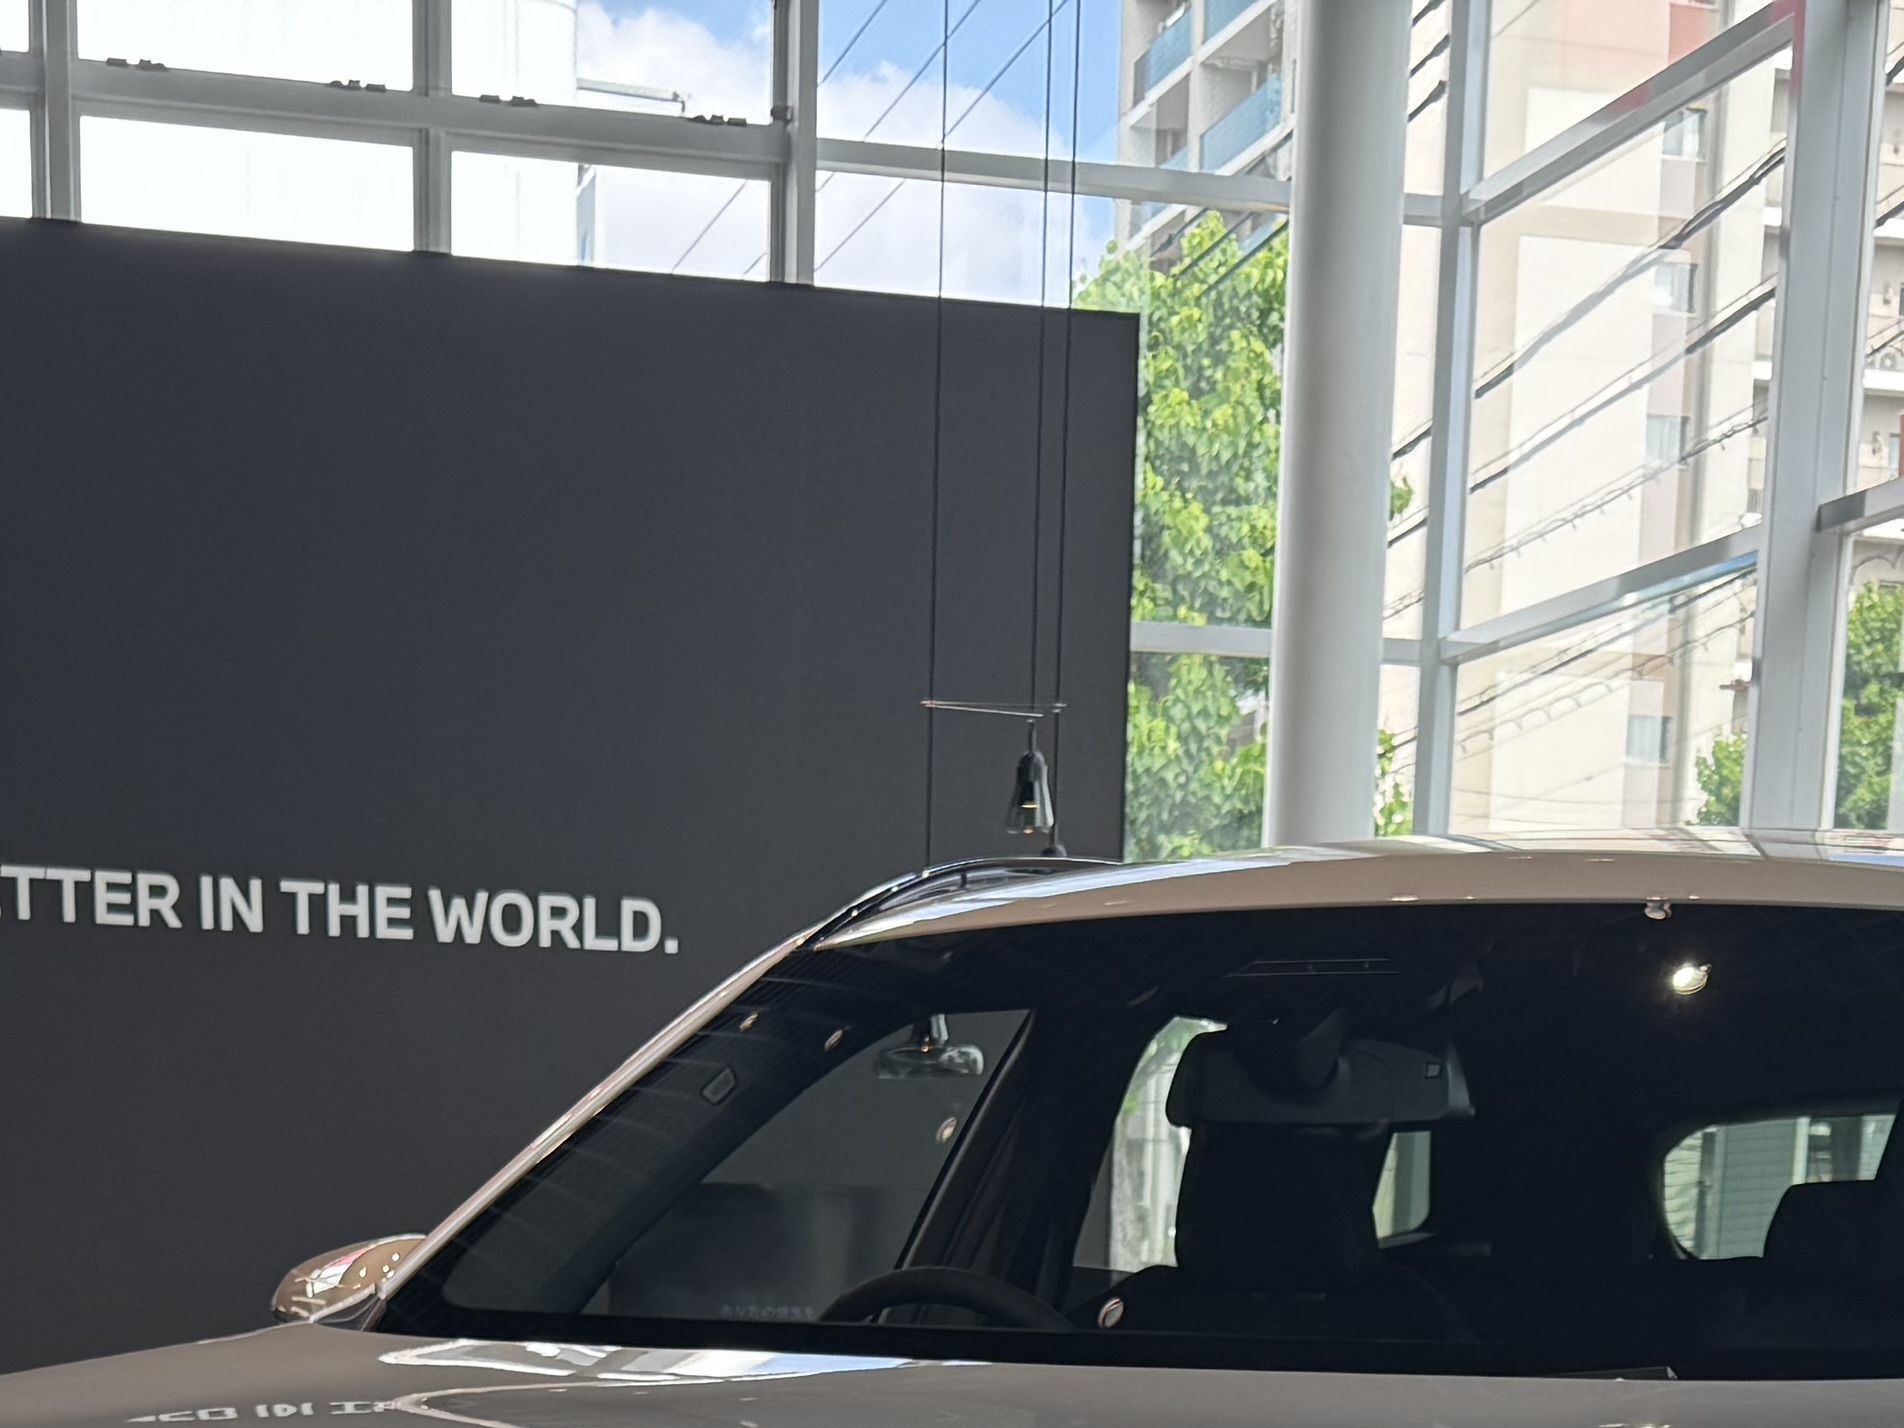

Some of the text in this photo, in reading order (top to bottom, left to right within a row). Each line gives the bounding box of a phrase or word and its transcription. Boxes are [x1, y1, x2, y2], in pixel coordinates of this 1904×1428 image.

[199, 874, 264, 933] IN
[279, 879, 414, 941] THE
[427, 887, 679, 955] WORLD.
